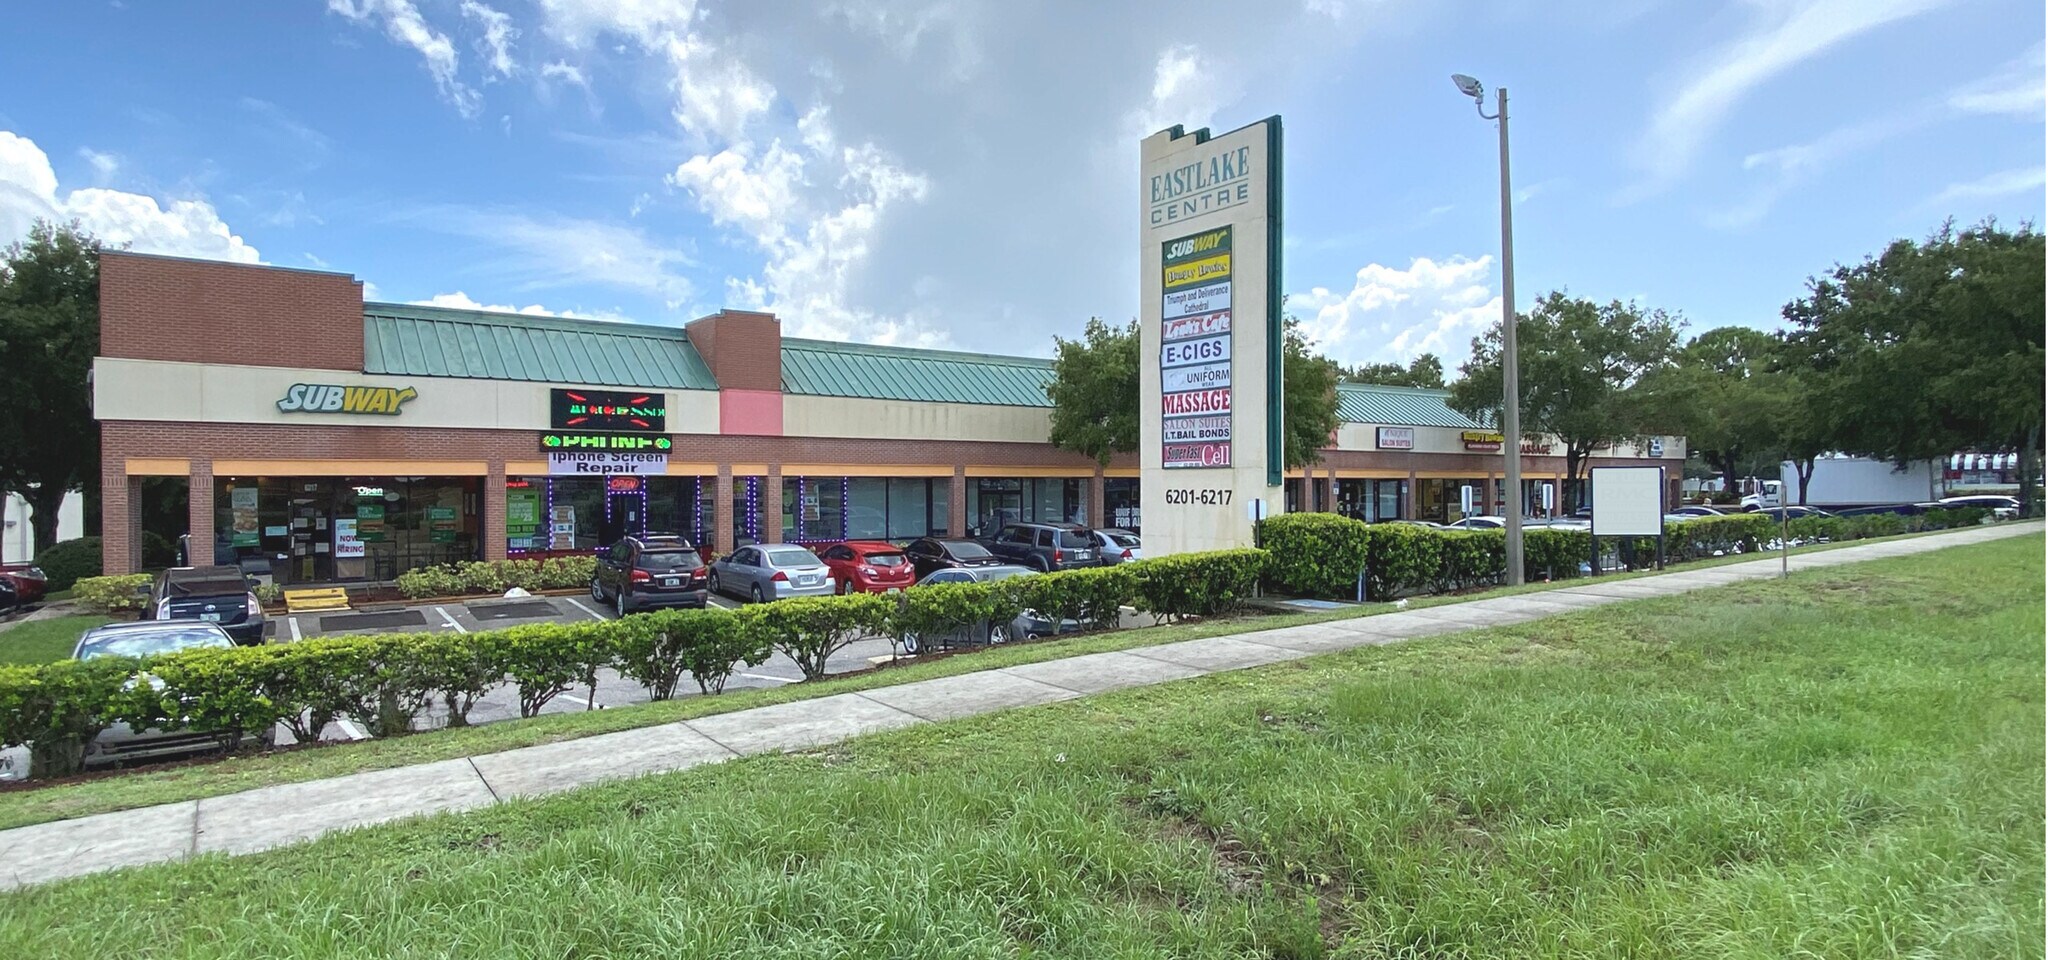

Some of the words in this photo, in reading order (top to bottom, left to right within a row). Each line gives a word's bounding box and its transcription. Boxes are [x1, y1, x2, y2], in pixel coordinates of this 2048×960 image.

[1150, 146, 1250, 204] EASTLAKE
[1151, 183, 1249, 225] CENTRE
[1167, 230, 1227, 259] SUBWAY
[1167, 293, 1187, 305] Triumph
[1187, 290, 1197, 300] and
[1198, 285, 1229, 299] Deliverance
[1184, 300, 1209, 313] Cathedral
[1166, 340, 1223, 363] E-CIGS
[1186, 369, 1230, 384] UNIFORM
[277, 383, 417, 414] SUBWAY
[1163, 389, 1230, 414] MASSAGE
[1164, 419, 1195, 430] SALON
[1199, 417, 1231, 429] SUITES
[1199, 428, 1230, 439] BONDS
[1202, 445, 1230, 466] Cell
[1519, 444, 1551, 454] ASSAGE
[610, 452, 663, 463] Screen
[576, 462, 639, 474] Repair
[611, 479, 638, 488] OPEN
[354, 486, 384, 496] Open
[1165, 489, 1233, 505] 6201-6217
[1115, 517, 1130, 527] FOR
[337, 544, 364, 553] HIRING
